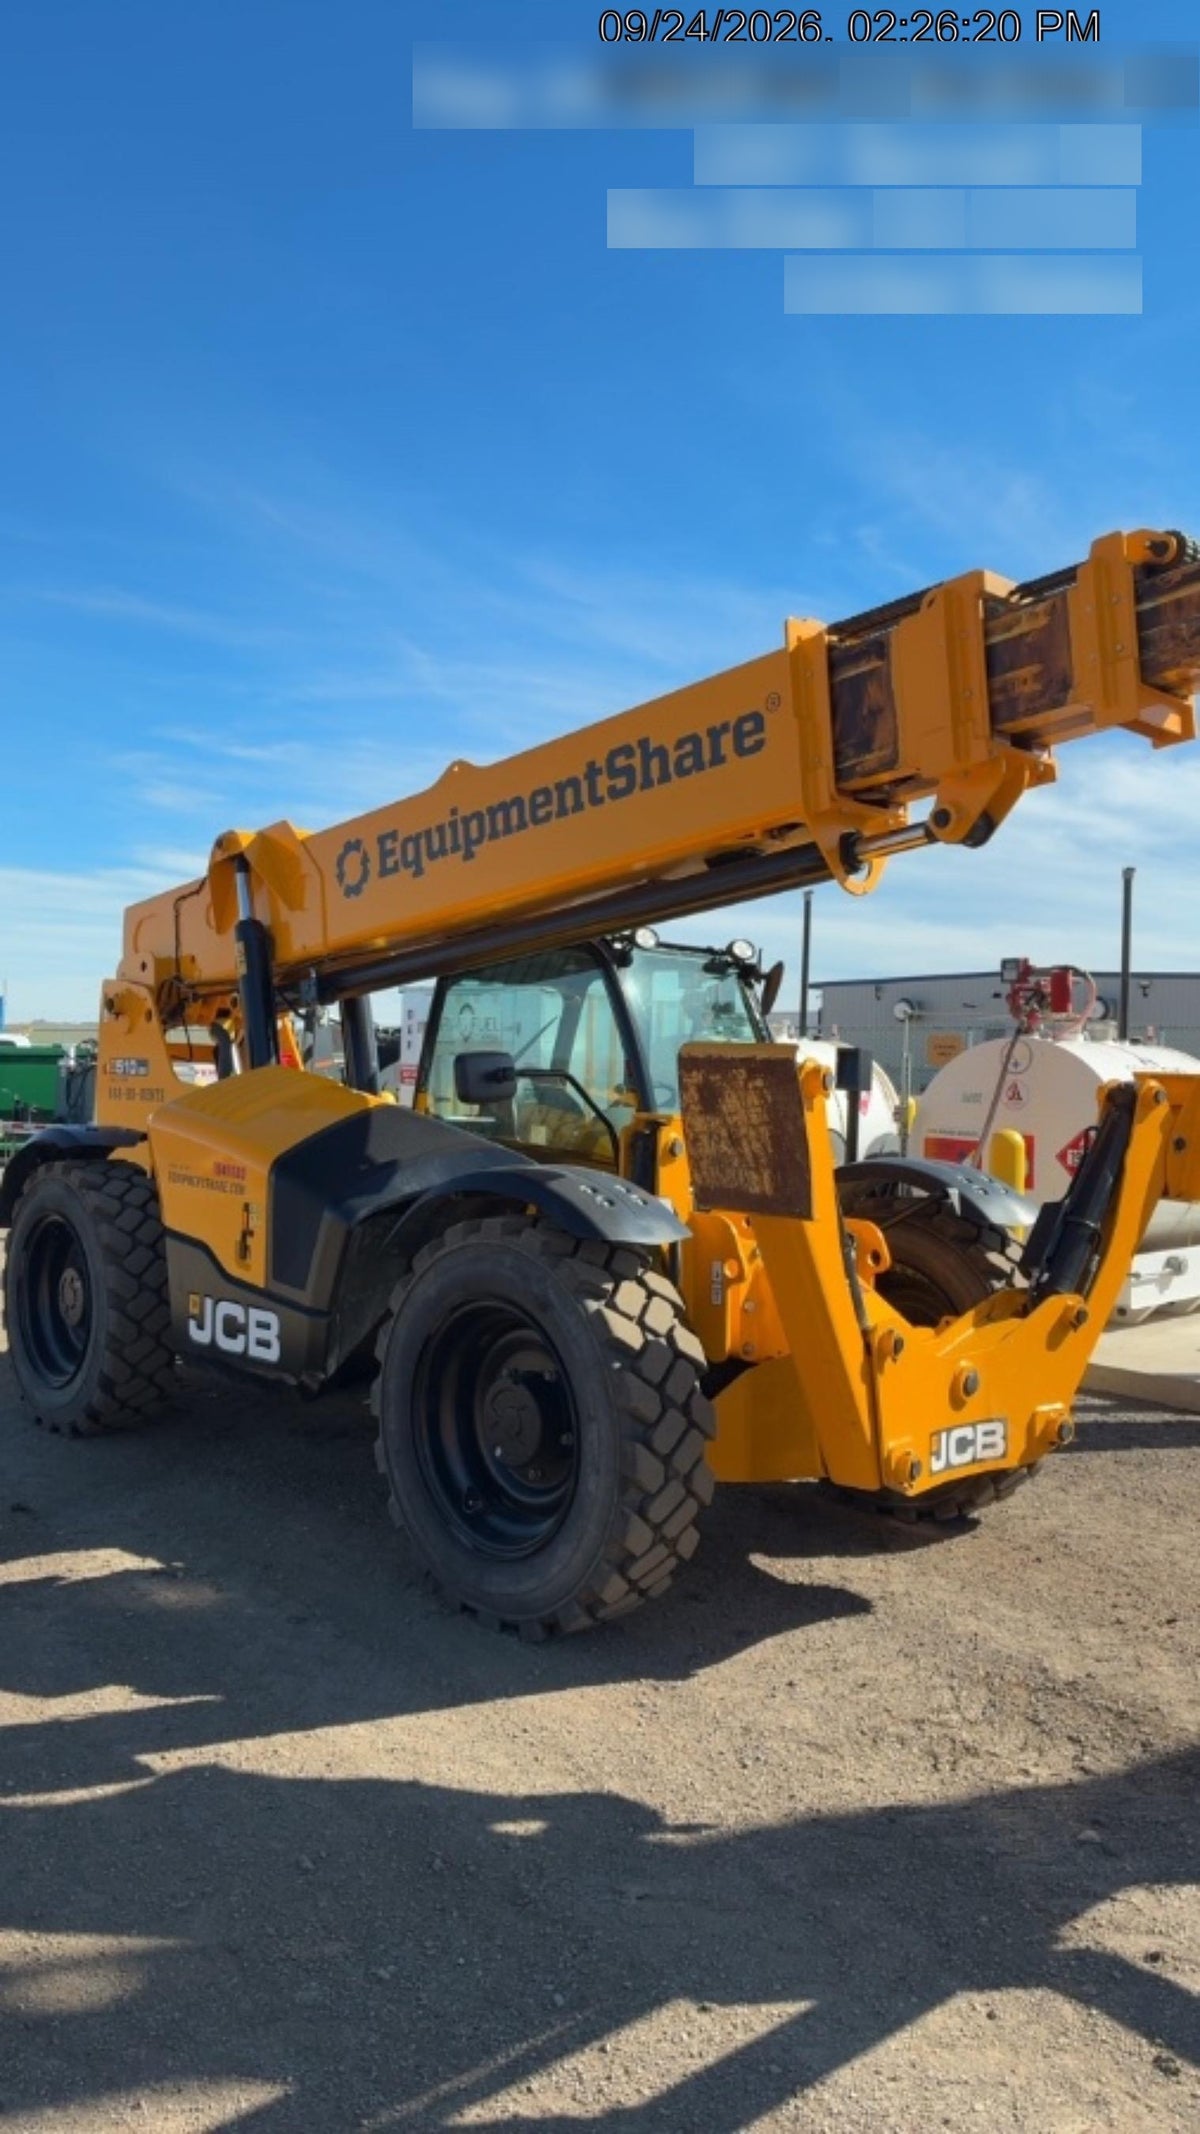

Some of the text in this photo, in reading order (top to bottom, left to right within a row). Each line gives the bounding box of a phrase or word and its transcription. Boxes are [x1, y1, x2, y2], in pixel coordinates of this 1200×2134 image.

[376, 709, 766, 878] EquipmentShare
[189, 1296, 281, 1362] JCB
[931, 1421, 1006, 1473] JCB
